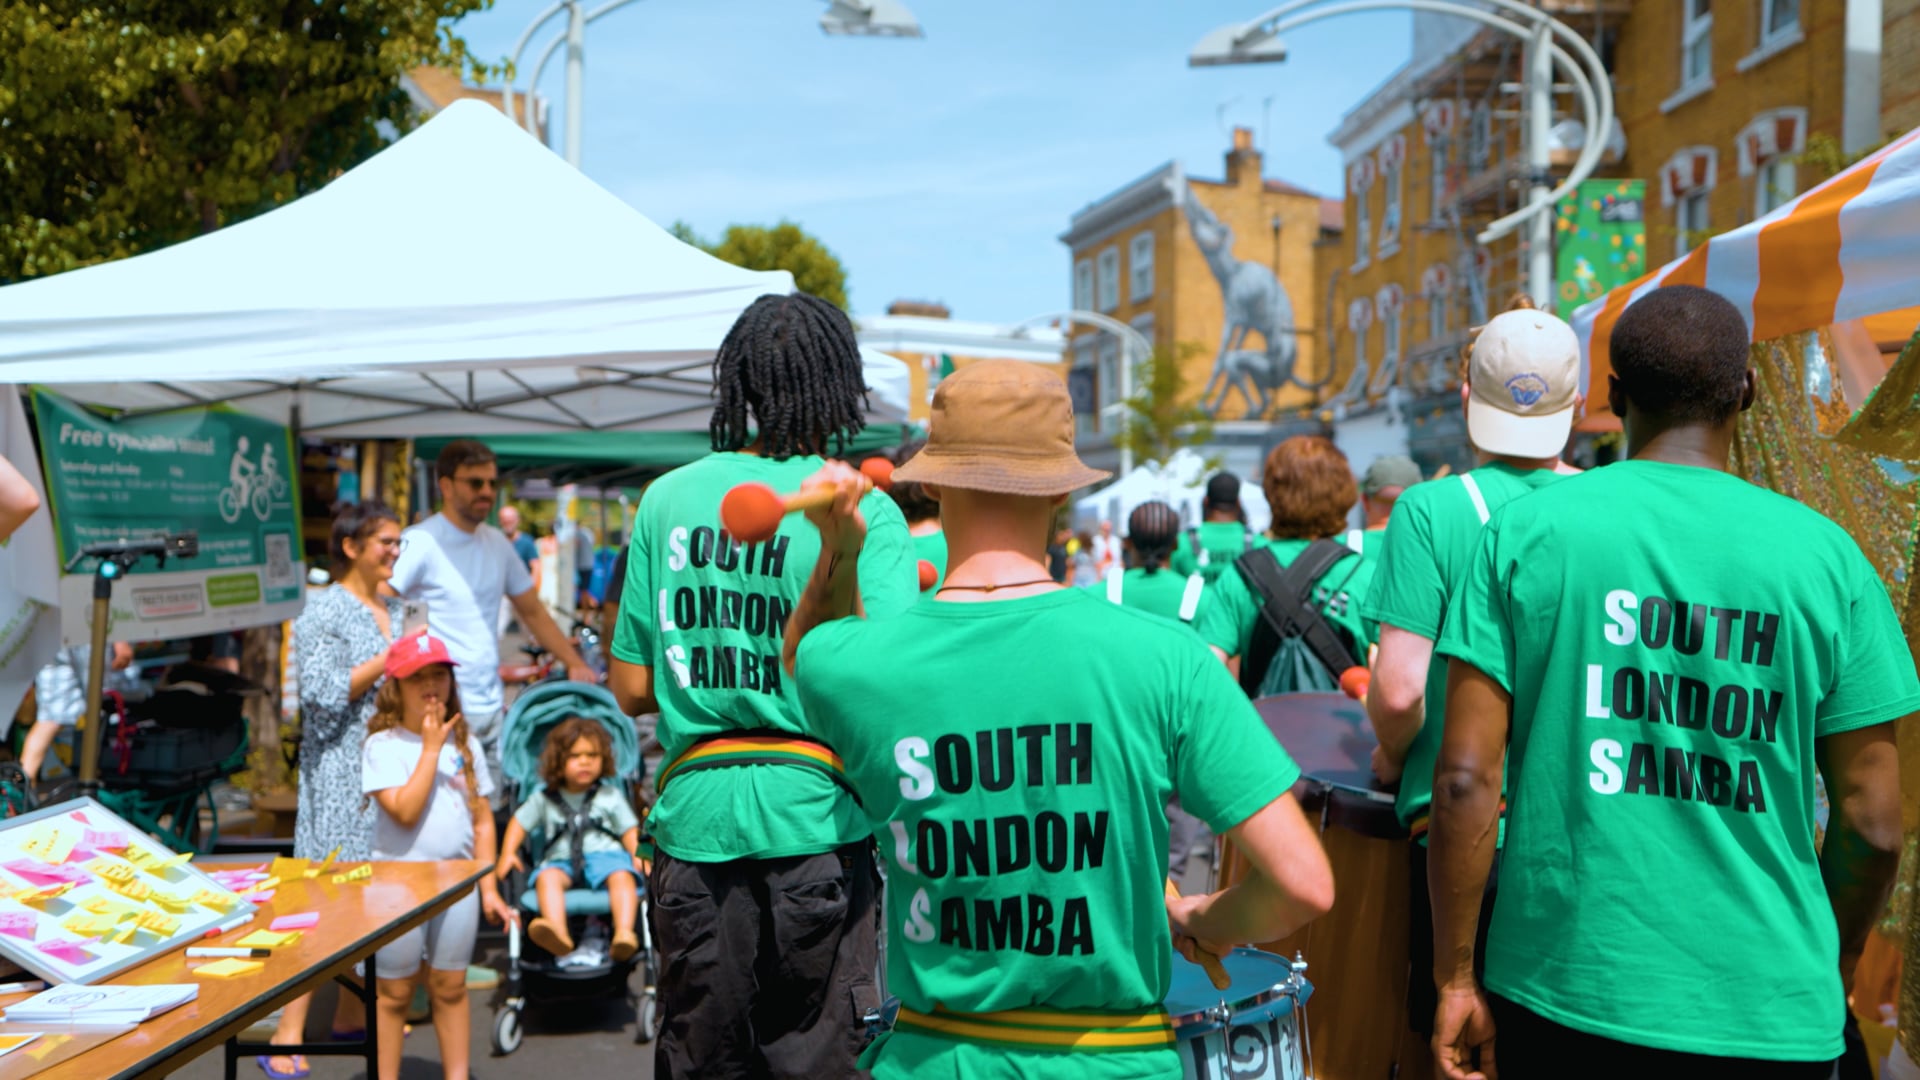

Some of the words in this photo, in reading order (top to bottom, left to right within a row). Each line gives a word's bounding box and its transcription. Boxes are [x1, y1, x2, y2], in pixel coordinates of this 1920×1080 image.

[60, 423, 103, 446] Free
[668, 526, 791, 578] SOUTH
[658, 586, 793, 639] LONDON
[1604, 589, 1780, 667] SOUTH
[665, 644, 783, 695] SAMBA
[1586, 664, 1784, 743] LONDON
[894, 722, 1093, 801] SOUTH
[1589, 738, 1767, 814] SAMBA
[889, 811, 1110, 879] LONDON
[904, 887, 1096, 957] SAMBA
